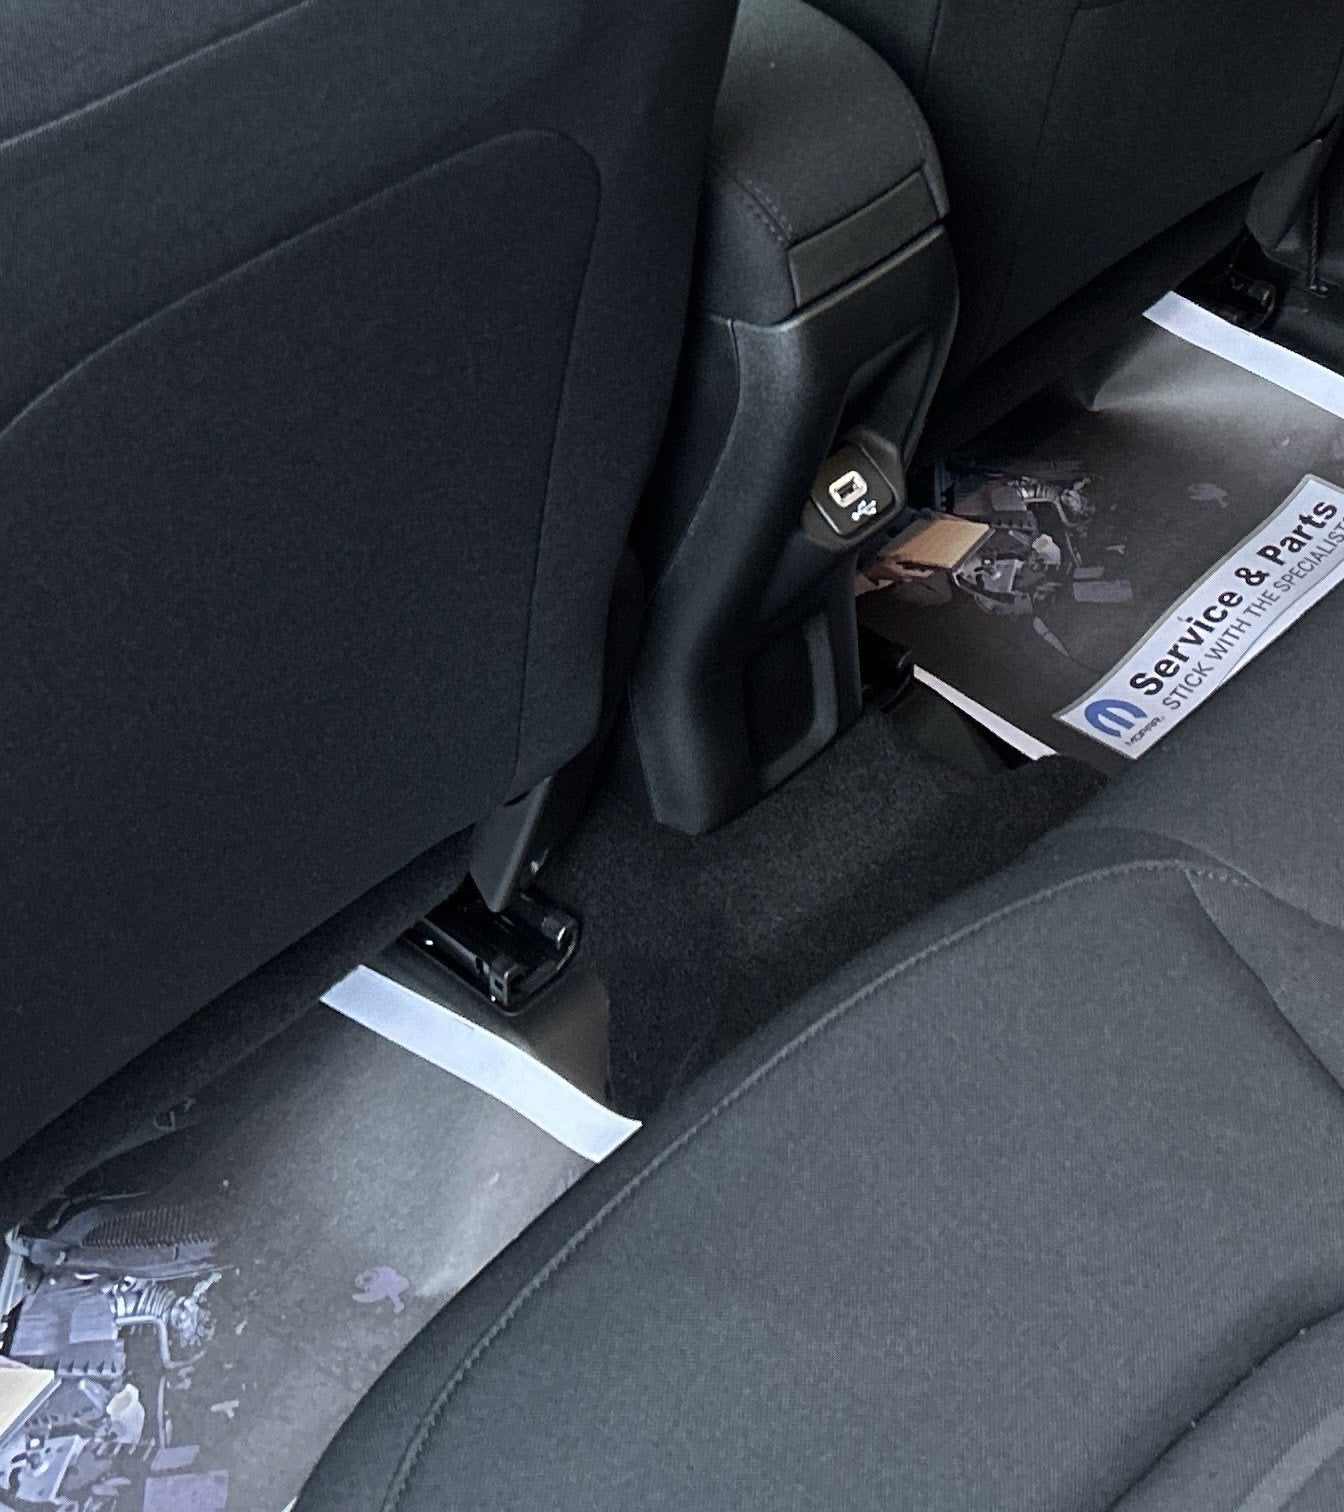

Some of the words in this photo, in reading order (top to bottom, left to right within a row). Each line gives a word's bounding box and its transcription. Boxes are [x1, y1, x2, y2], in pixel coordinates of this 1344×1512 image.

[1129, 590, 1244, 696] Service
[1234, 567, 1270, 587] &
[1256, 501, 1338, 567] Parts
[1162, 661, 1215, 710] STICK
[1204, 617, 1252, 661] WITH
[1243, 590, 1281, 618] THE
